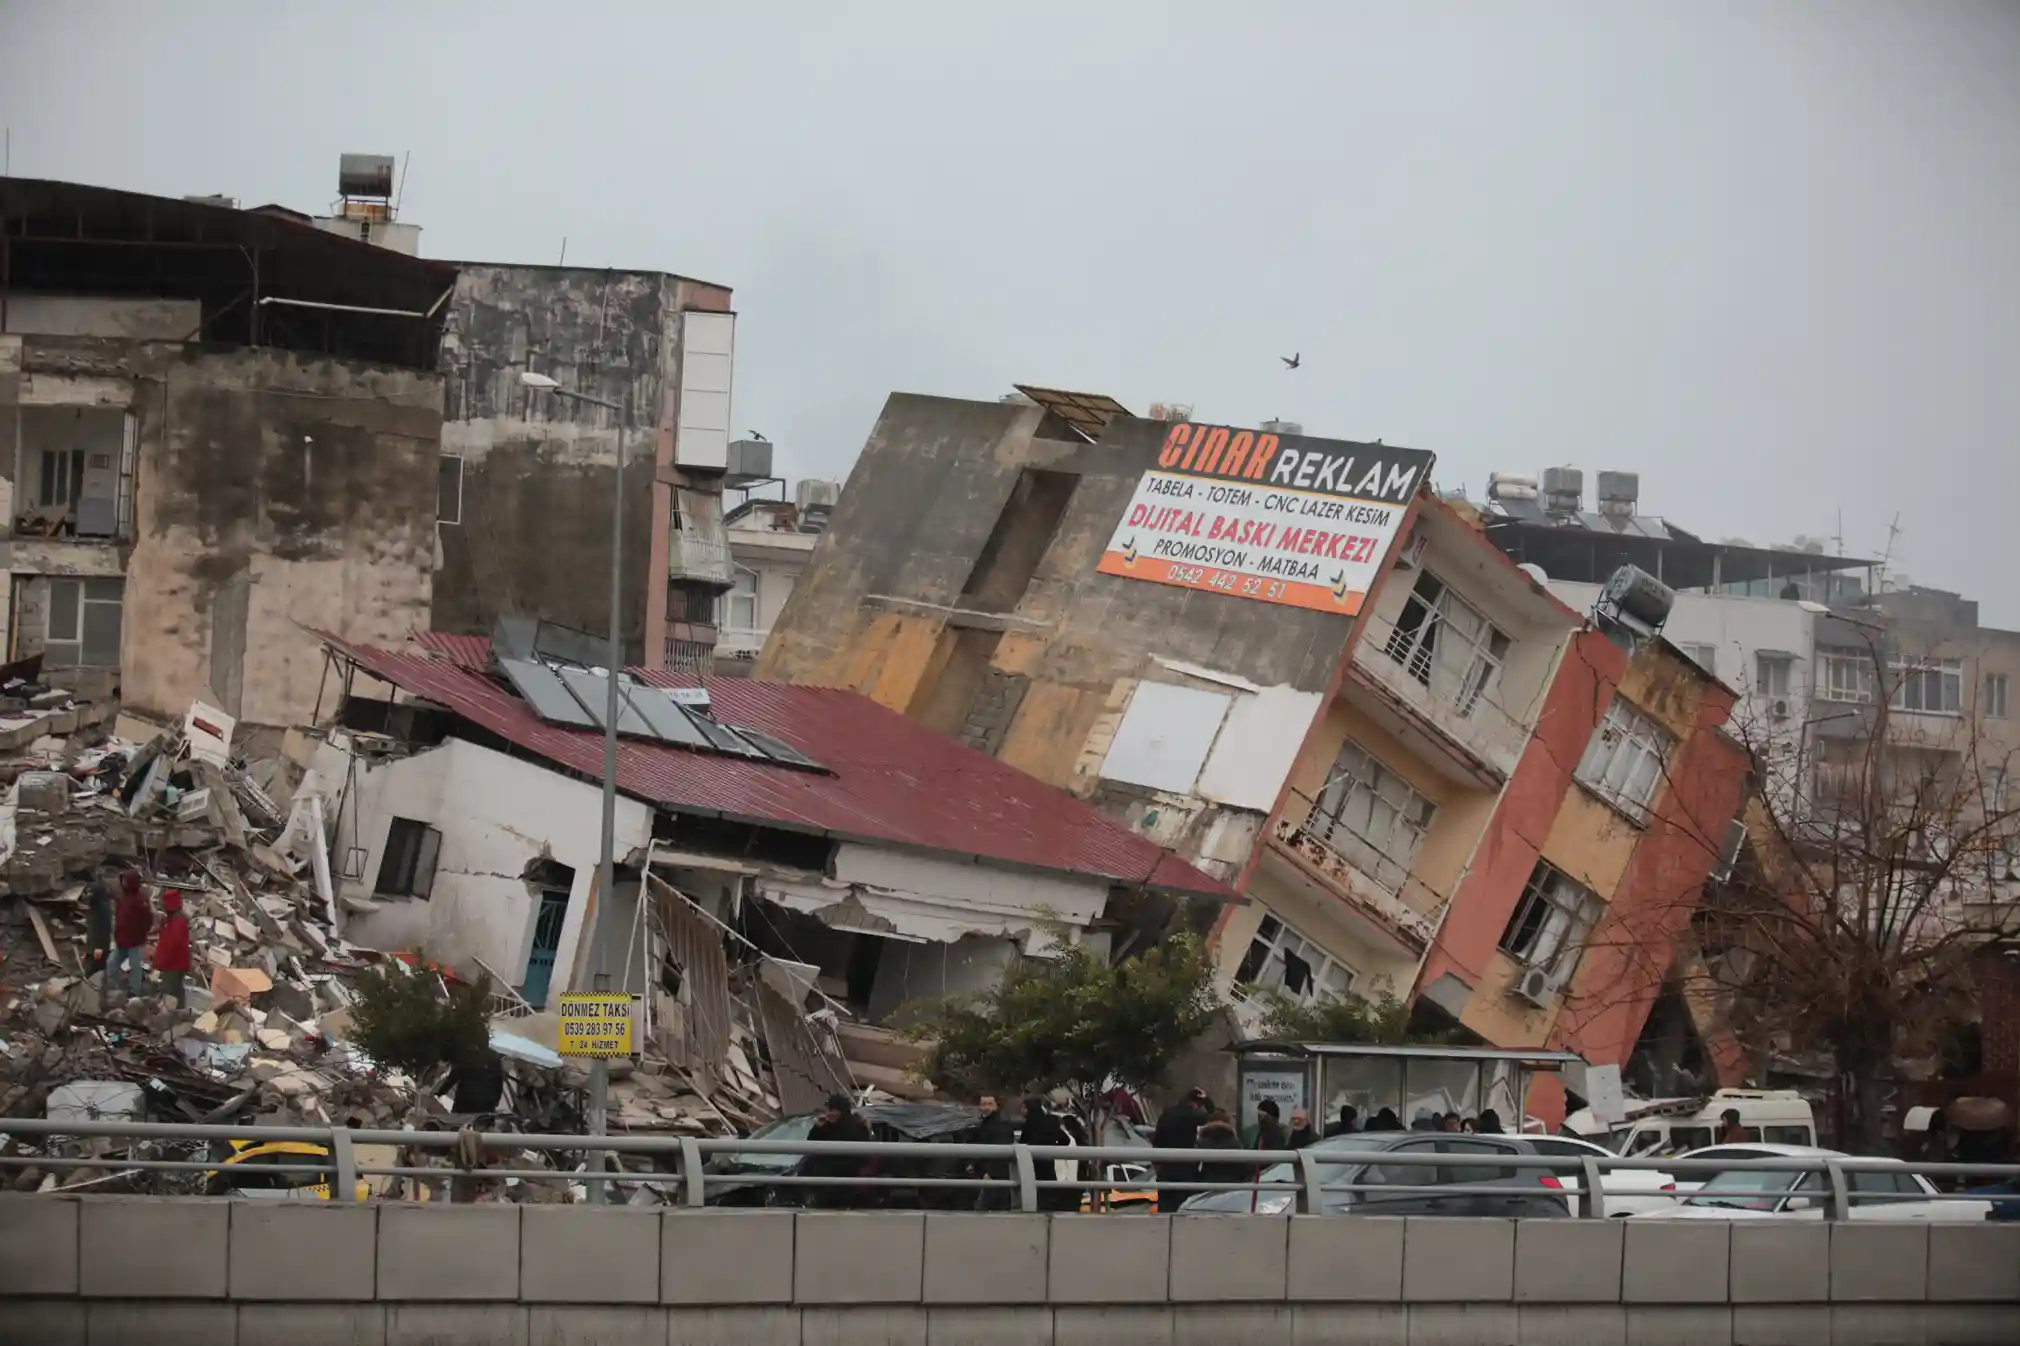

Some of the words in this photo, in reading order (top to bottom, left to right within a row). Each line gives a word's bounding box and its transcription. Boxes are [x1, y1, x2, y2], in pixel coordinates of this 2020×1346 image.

[1270, 448, 1417, 500] REKLAM
[1146, 477, 1194, 499] TABELA
[1206, 486, 1253, 507] TOTEM
[1264, 494, 1299, 513] CNC
[1300, 499, 1344, 520] LAZER
[1207, 515, 1277, 549] BASKI
[1153, 538, 1247, 568] PROMOSYON
[1256, 555, 1319, 580] MATBAA
[1168, 564, 1204, 585] 0542
[1242, 576, 1262, 595] 52
[564, 1022, 584, 1036] 0539
[585, 1022, 601, 1036] 283
[603, 1022, 613, 1036] 97
[615, 1022, 625, 1036] 56
